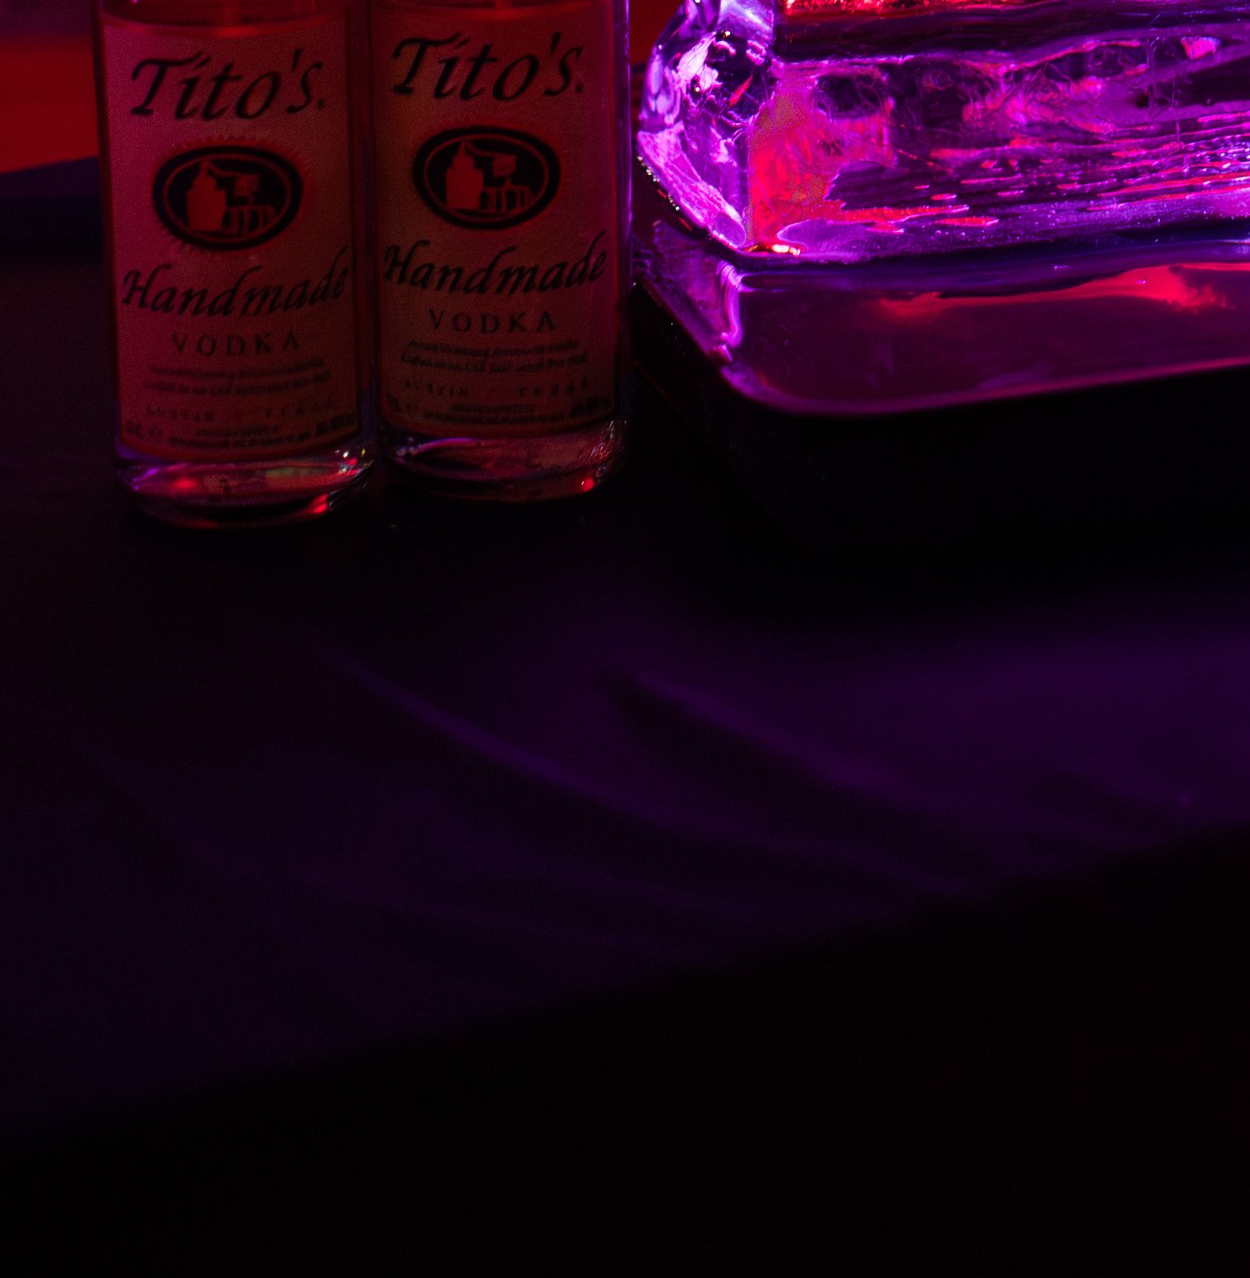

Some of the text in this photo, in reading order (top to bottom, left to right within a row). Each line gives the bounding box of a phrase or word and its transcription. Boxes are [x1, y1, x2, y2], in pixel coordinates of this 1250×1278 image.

[122, 246, 348, 316] Handmade
[384, 230, 607, 294] Handmade
[171, 330, 300, 356] VODKA
[429, 309, 556, 333] VODKA
